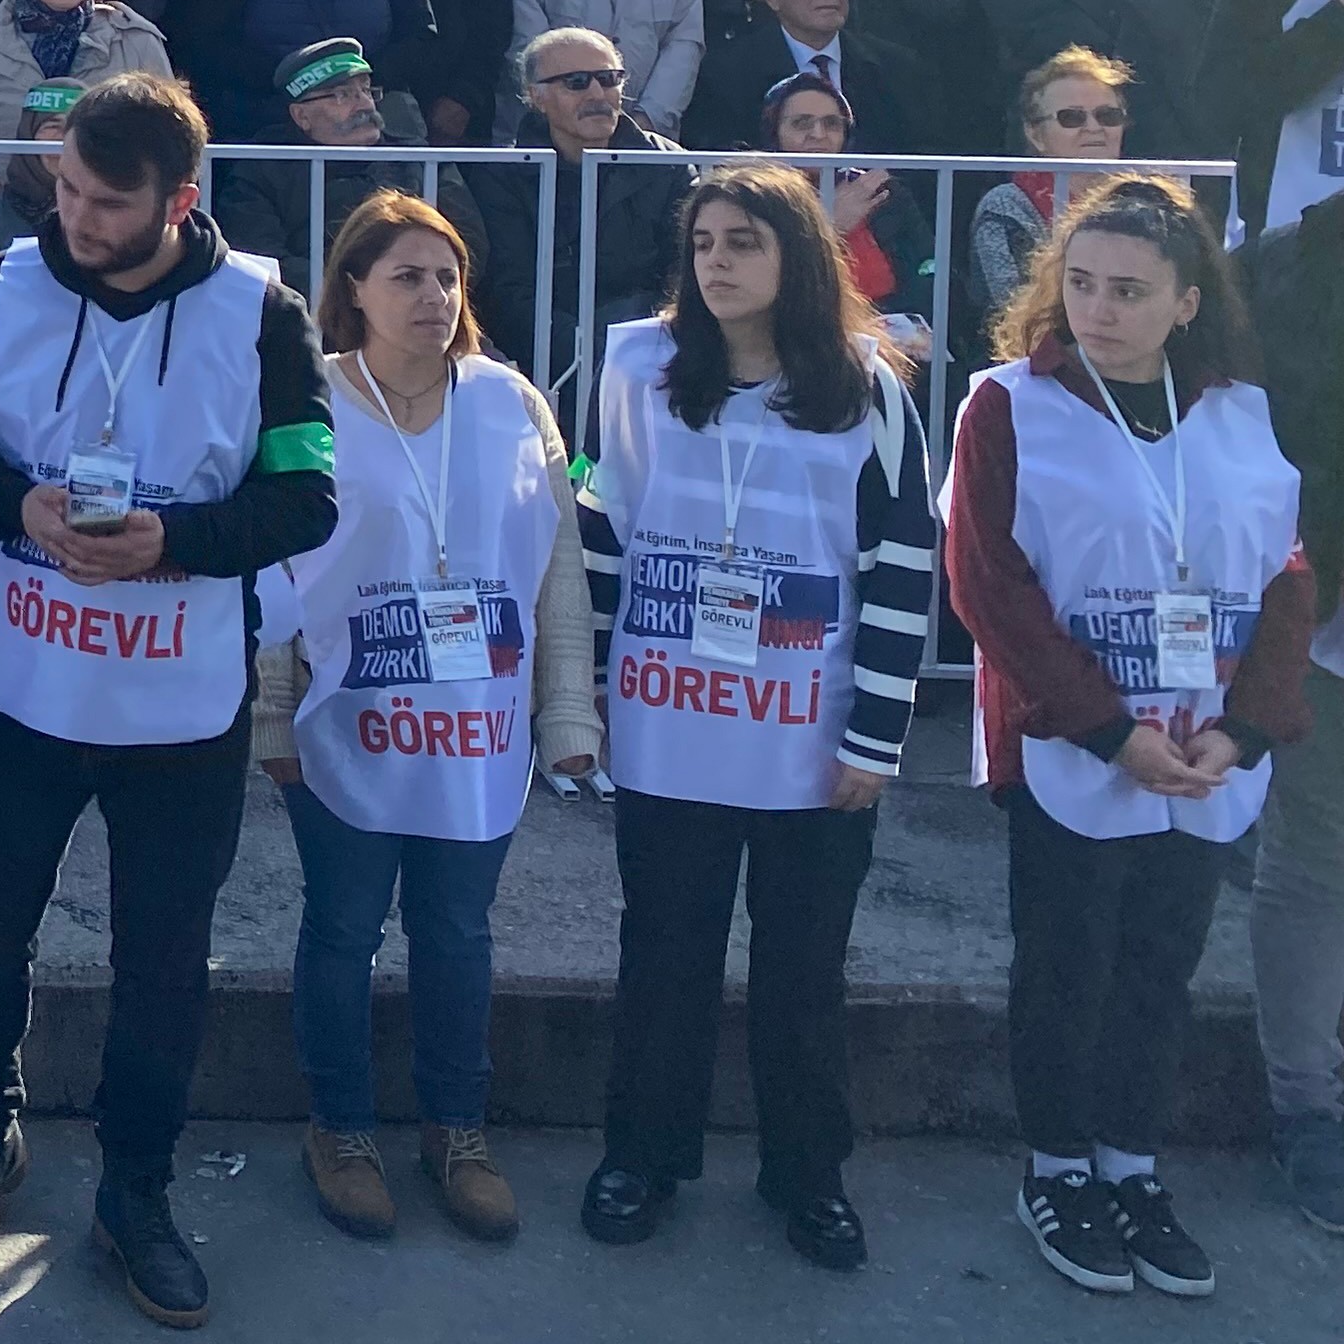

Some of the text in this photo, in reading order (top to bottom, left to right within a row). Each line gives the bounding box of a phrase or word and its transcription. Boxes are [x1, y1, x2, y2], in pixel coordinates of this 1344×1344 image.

[285, 60, 334, 99] MEDET
[646, 529, 691, 551] Eğitim,
[752, 545, 799, 567] Yaşam
[6, 576, 188, 660] GÖREVLİ
[431, 628, 481, 644] GÖREVLİ
[701, 608, 754, 631] GÖREVLİ
[359, 640, 428, 679] TÜRKİ
[619, 647, 821, 725] GÖREVLİ
[358, 695, 517, 758] GÖREVLİ
